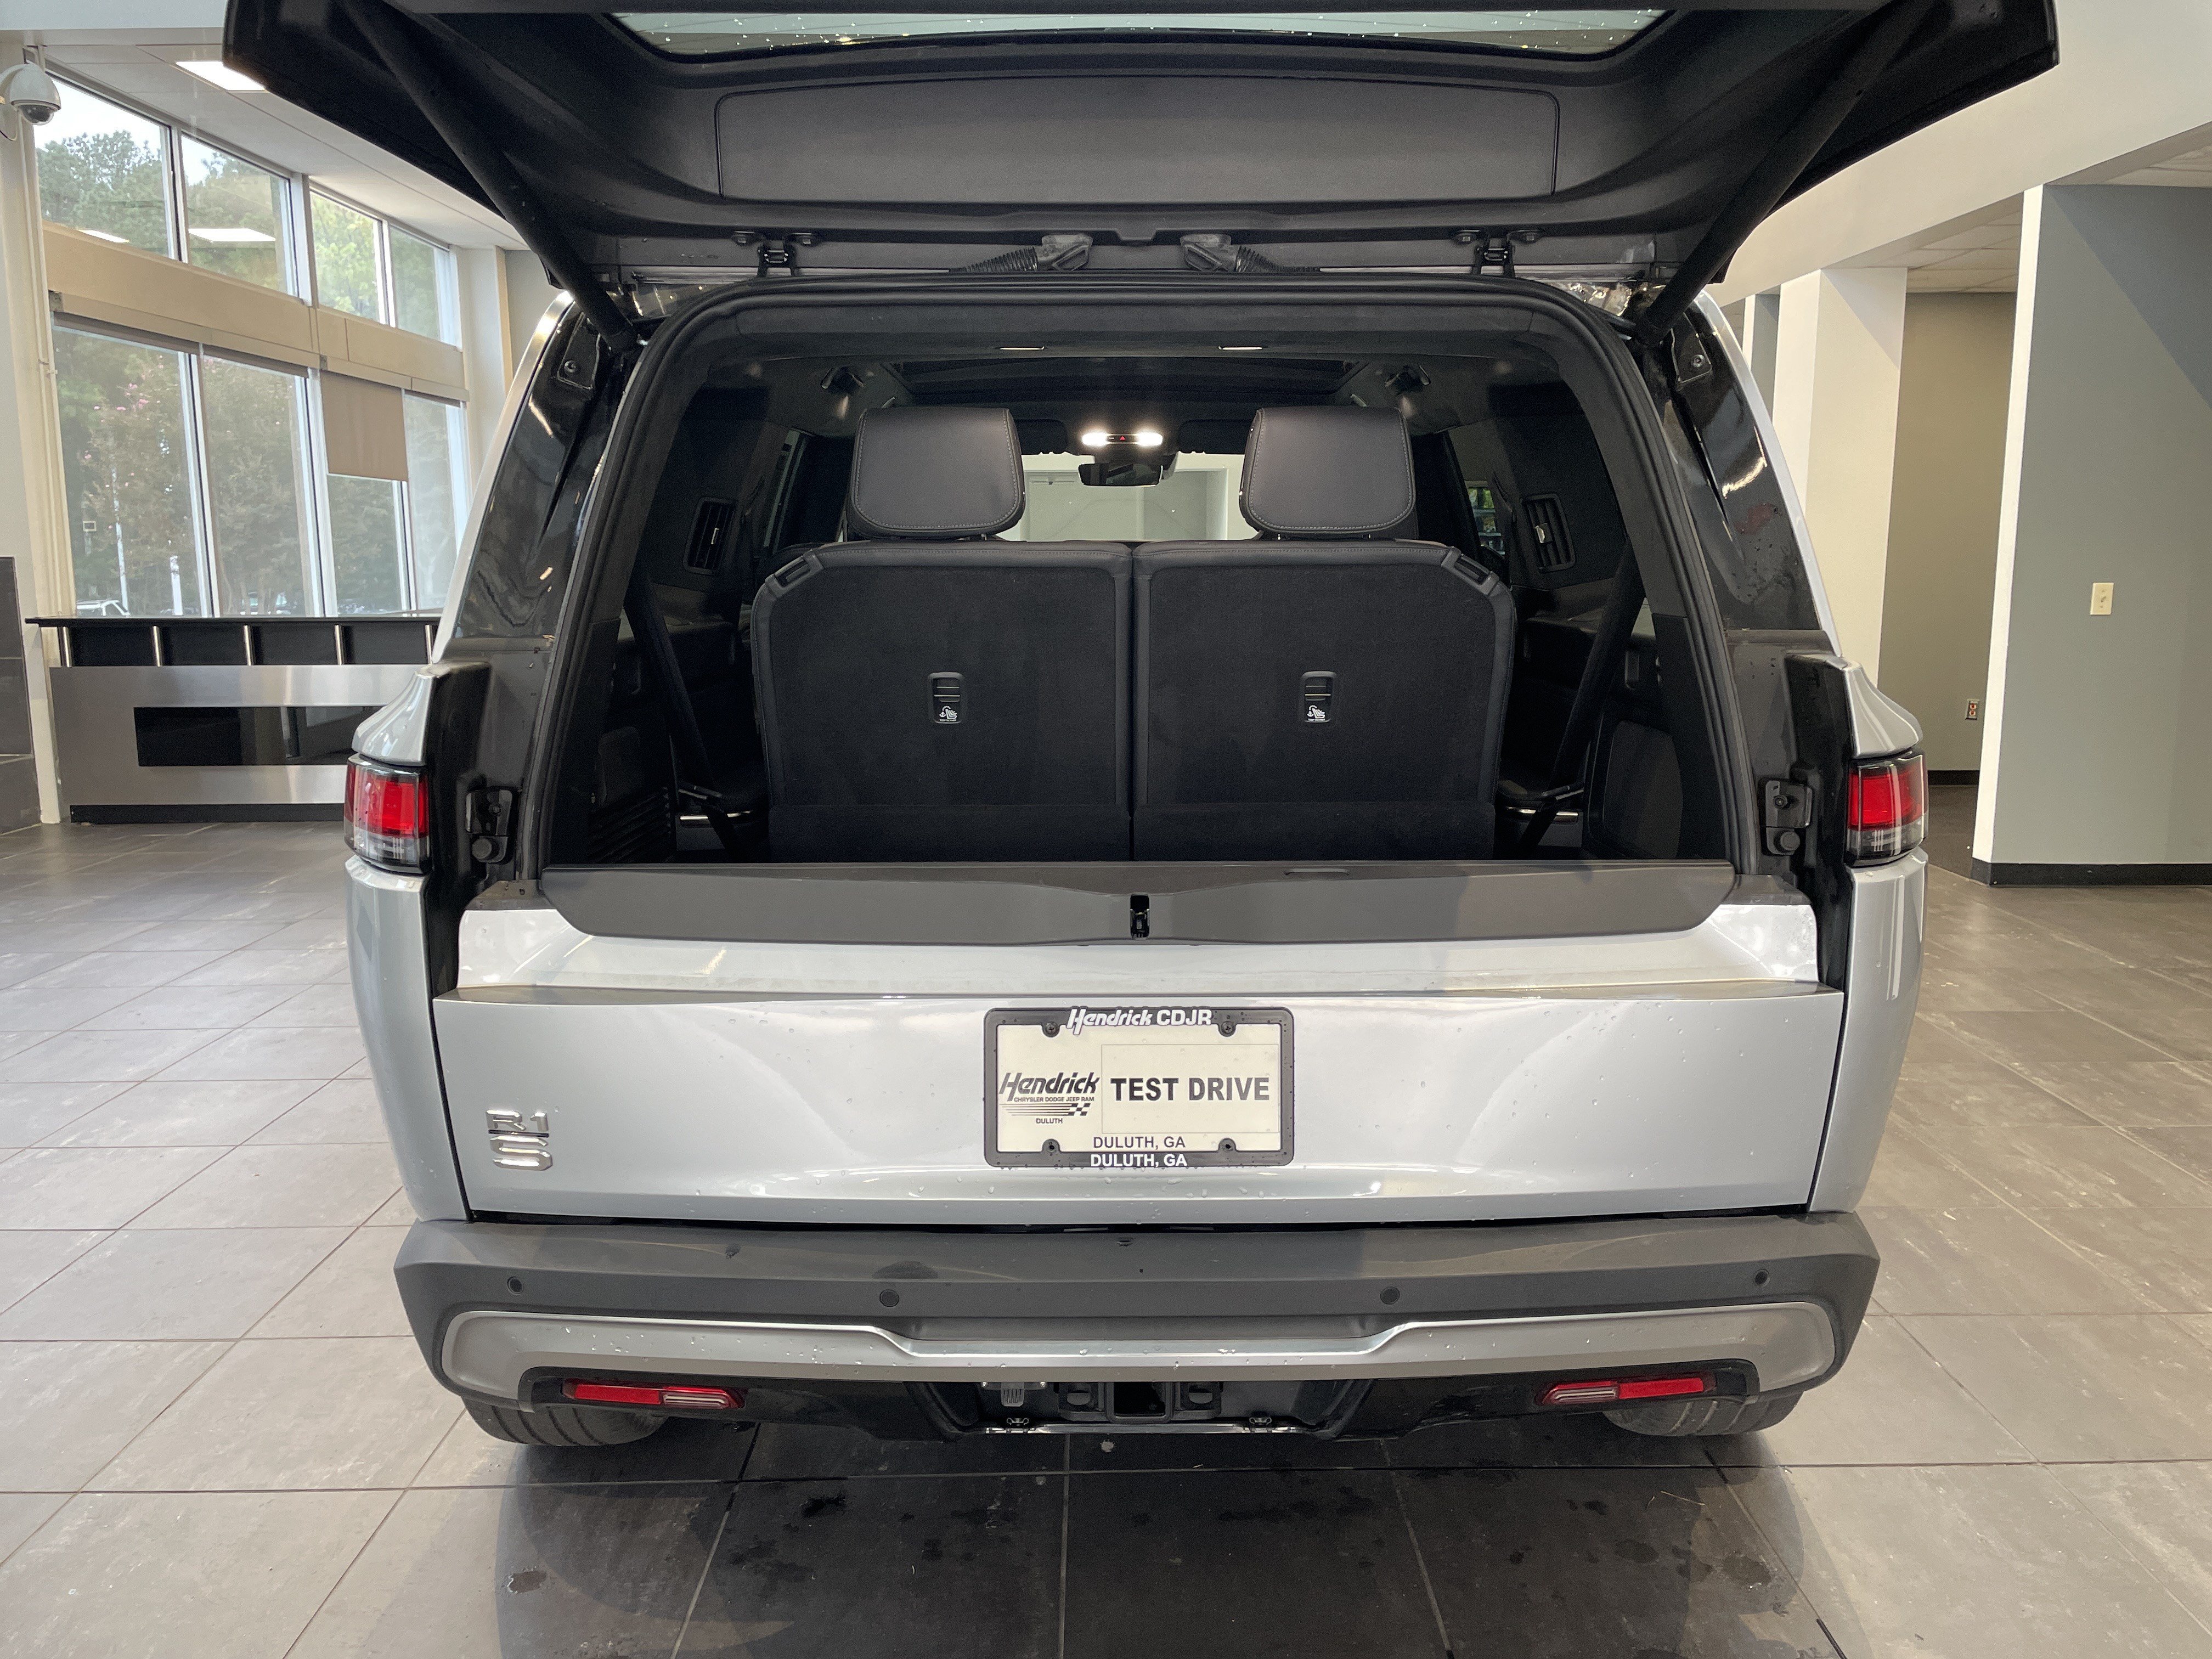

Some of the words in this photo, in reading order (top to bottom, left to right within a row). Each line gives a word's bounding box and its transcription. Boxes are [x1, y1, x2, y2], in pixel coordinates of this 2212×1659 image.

[1066, 1008, 1153, 1035] Hendrick
[1156, 1009, 1212, 1026] CDJR
[998, 1072, 1099, 1102] Hendrick
[1110, 1077, 1179, 1101] TEST
[1189, 1077, 1269, 1101] DRIVE
[1093, 1137, 1159, 1149] DULUTH,
[1164, 1136, 1186, 1148] GA
[1090, 1154, 1159, 1167] DULUTH,
[1163, 1153, 1188, 1166] GA
